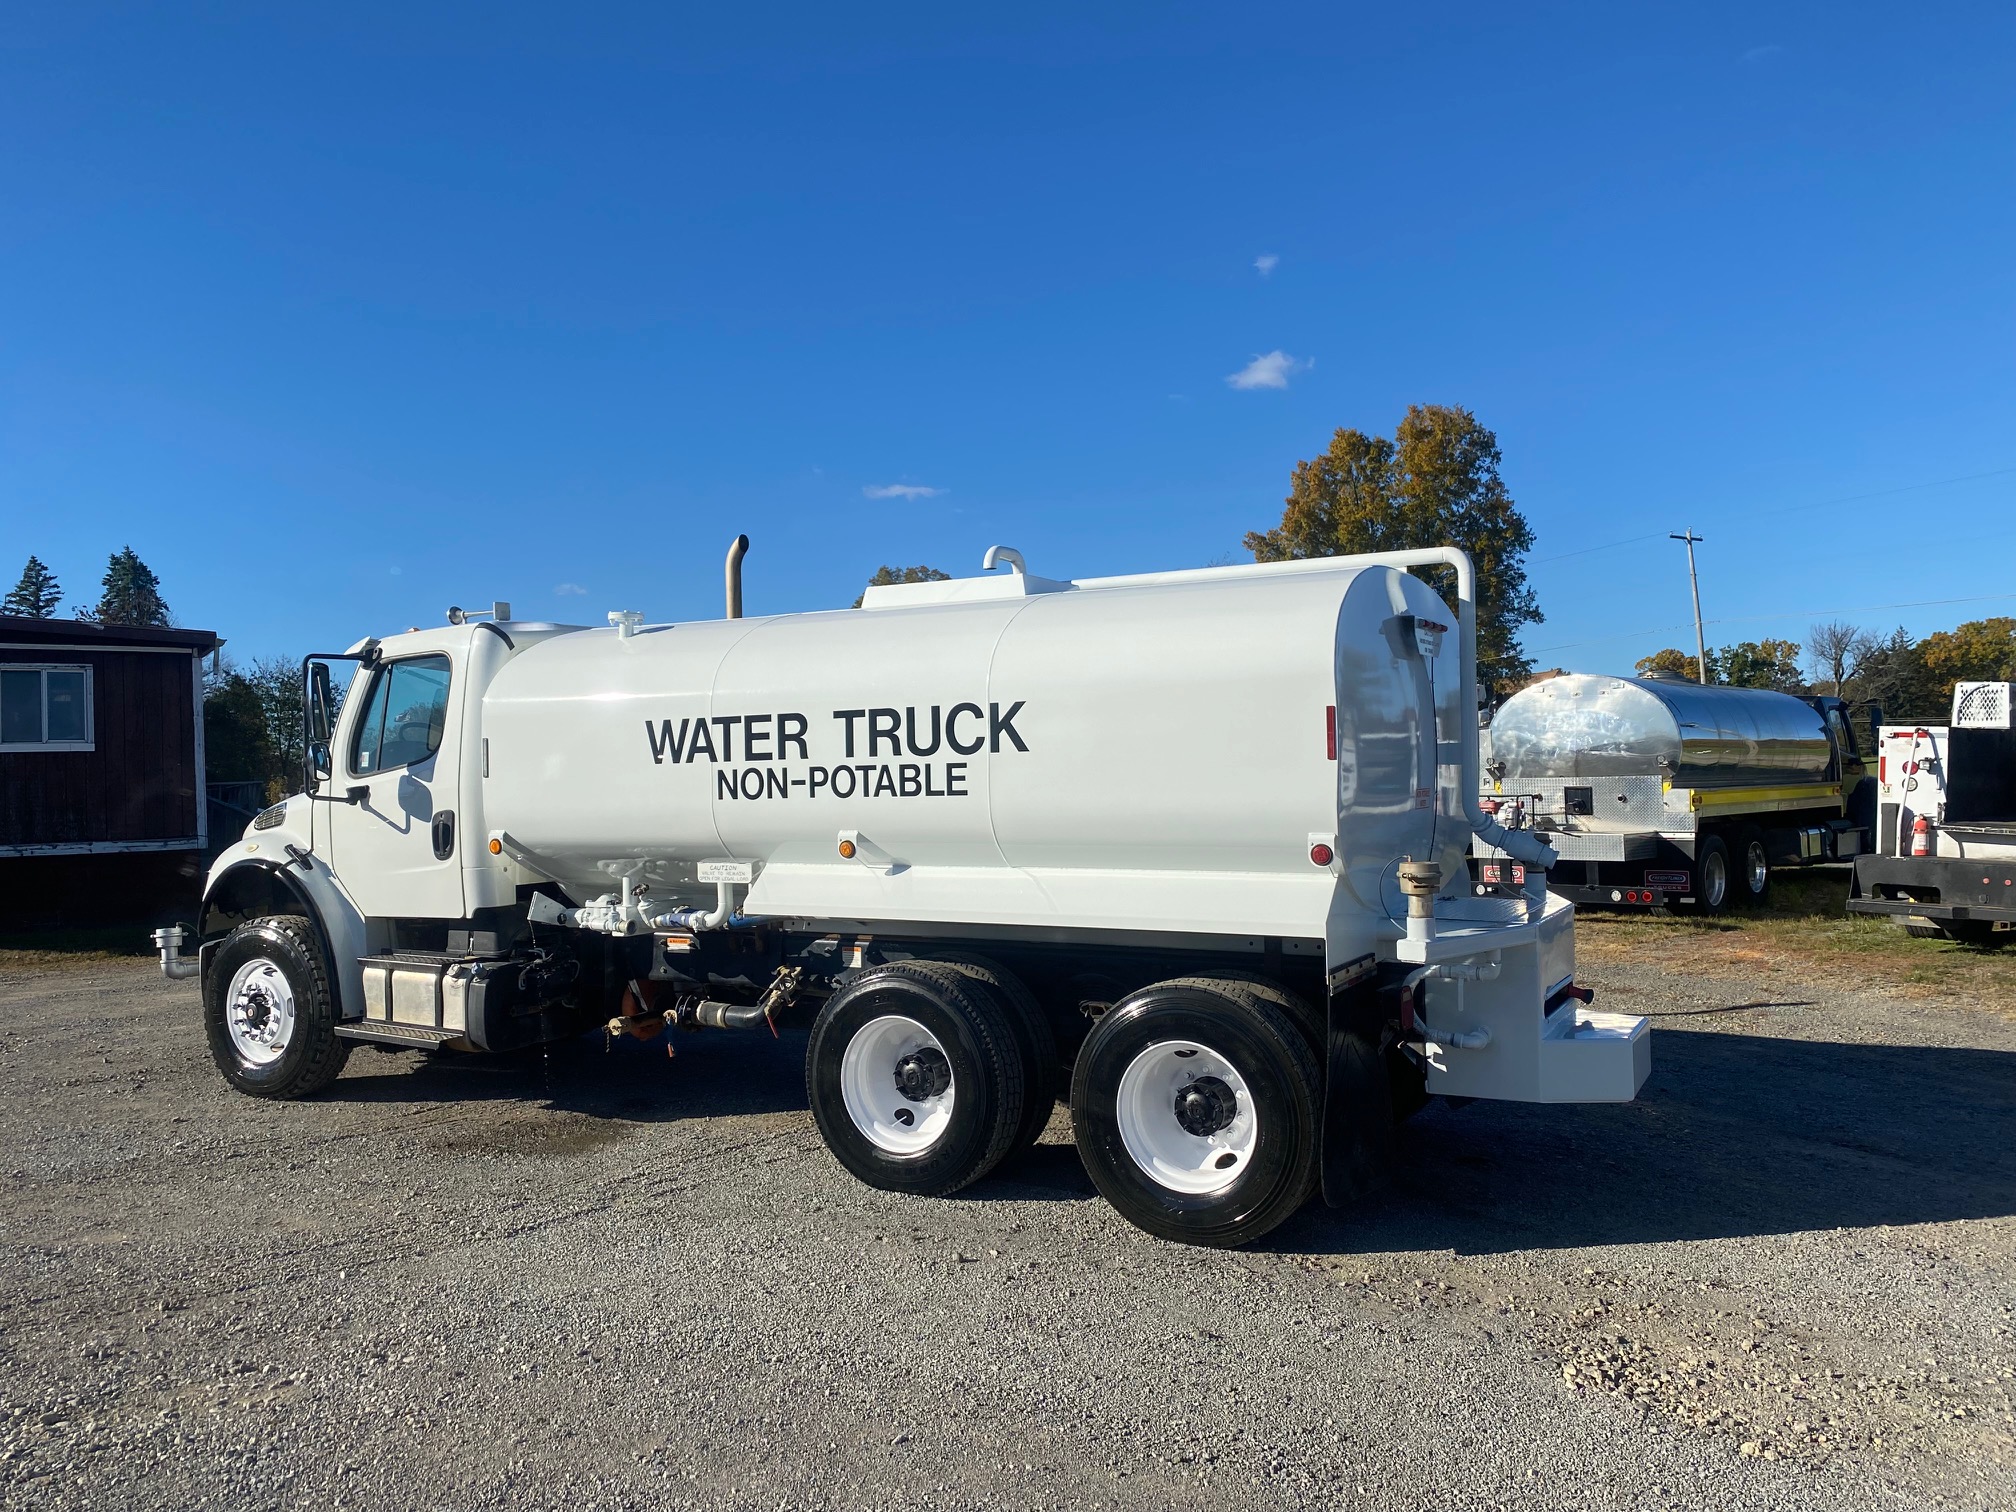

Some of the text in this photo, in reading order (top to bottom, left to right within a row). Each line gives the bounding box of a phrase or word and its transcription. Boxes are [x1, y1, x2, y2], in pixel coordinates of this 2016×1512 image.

[645, 701, 1030, 765] WATER TRUCK
[717, 762, 969, 800] NON-POTABLE
